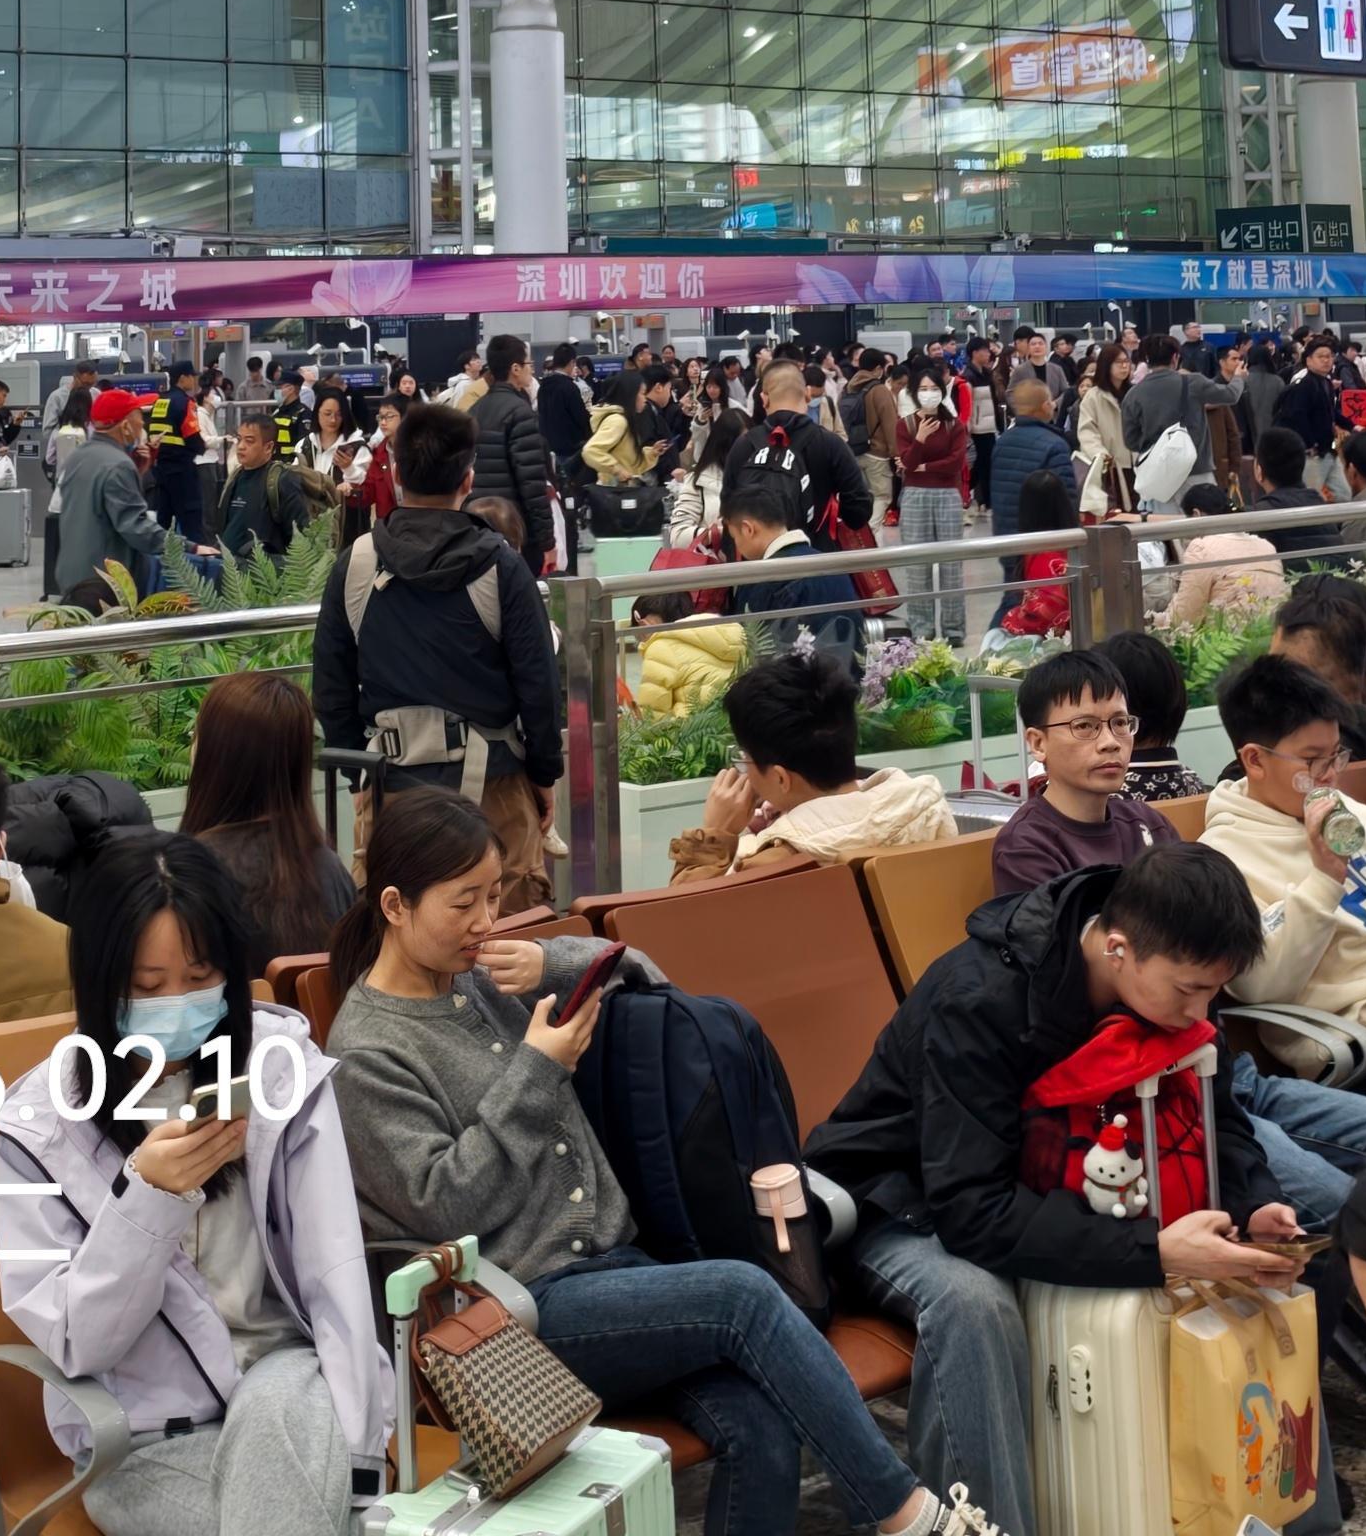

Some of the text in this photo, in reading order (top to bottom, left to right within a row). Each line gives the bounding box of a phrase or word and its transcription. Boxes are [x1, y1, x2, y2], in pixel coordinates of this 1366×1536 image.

[1268, 219, 1299, 239] 出口
[1328, 220, 1349, 238] 出口
[1269, 239, 1290, 251] Exit
[516, 262, 705, 301] 深圳欢迎你
[1180, 259, 1336, 291] 来了就是深圳人
